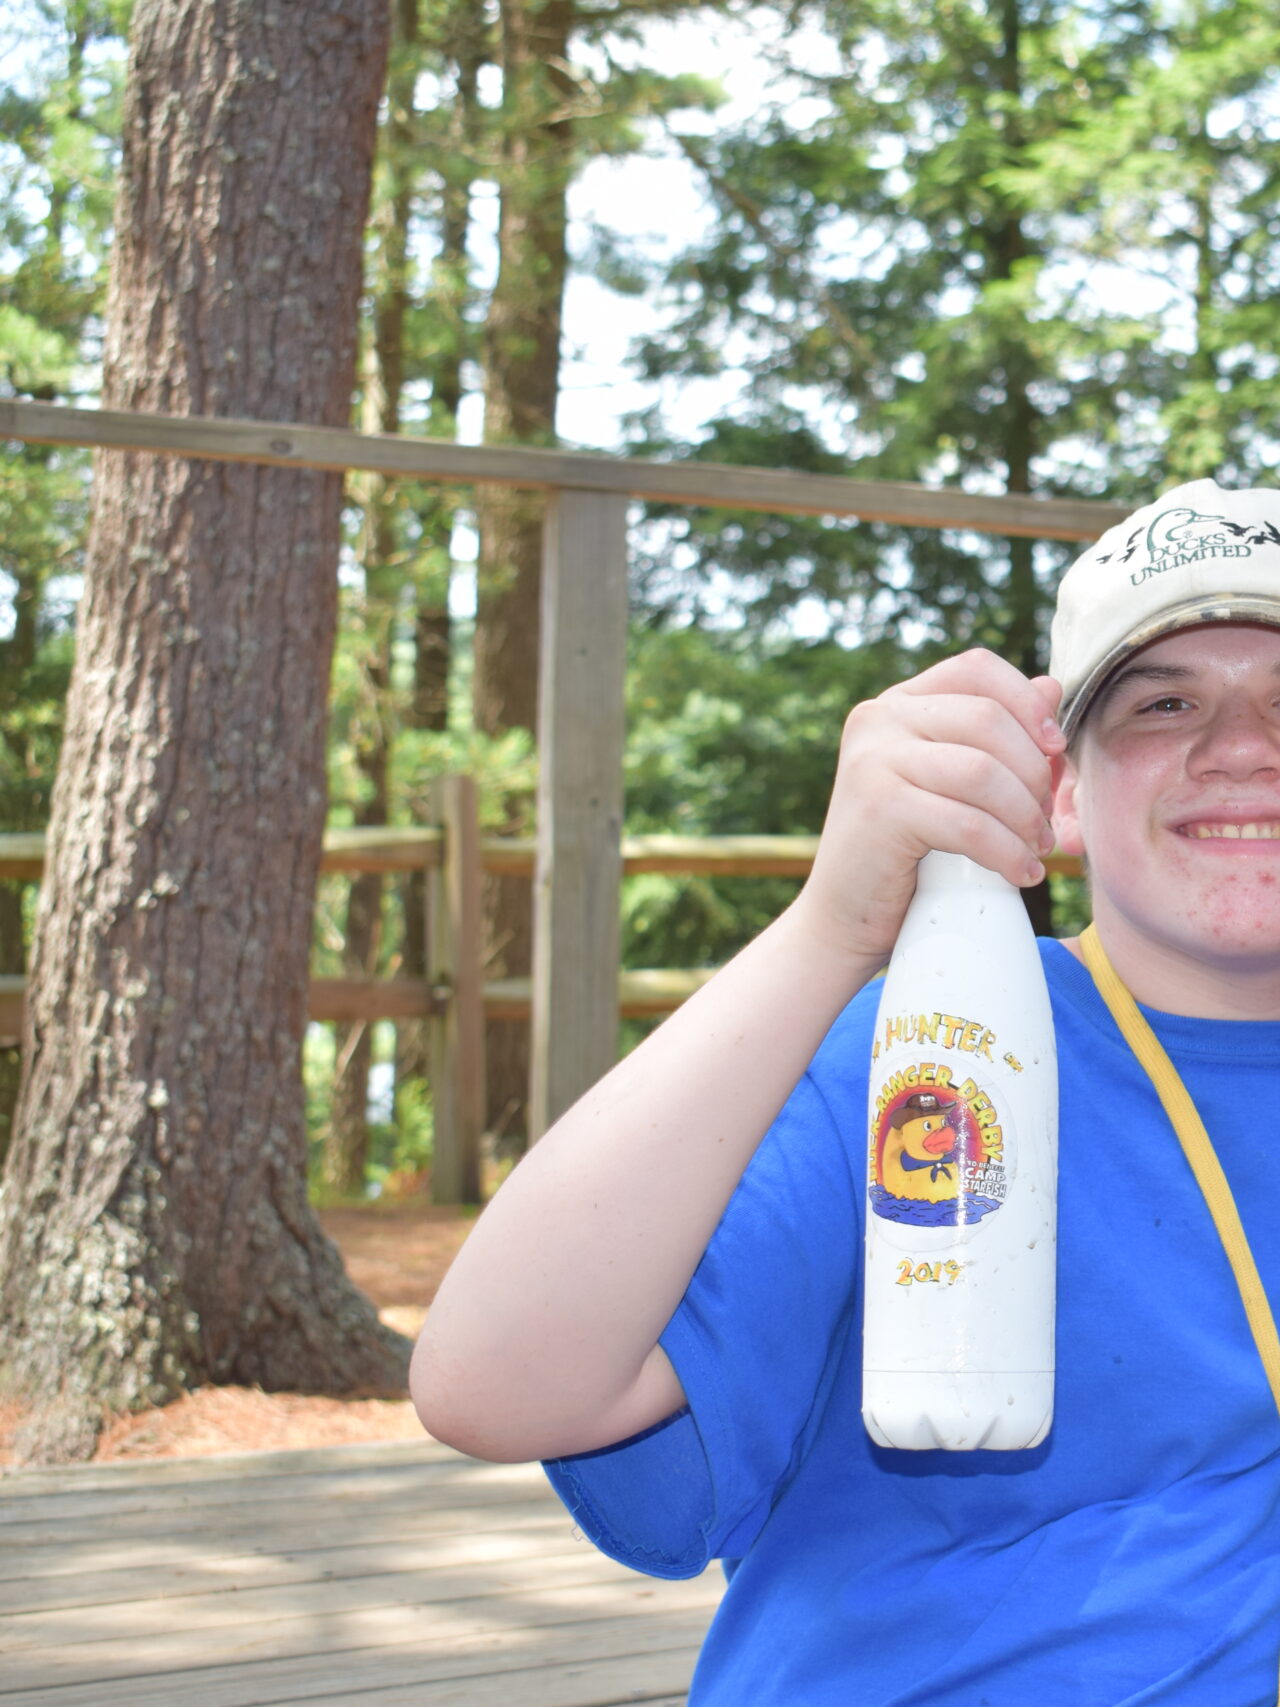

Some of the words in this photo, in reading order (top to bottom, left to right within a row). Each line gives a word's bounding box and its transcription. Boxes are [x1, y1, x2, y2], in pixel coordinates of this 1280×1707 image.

[1149, 532, 1226, 564] DUCKS
[1130, 545, 1252, 586] UNLIMITED
[885, 1012, 997, 1062] HUNTER
[875, 1062, 952, 1115] RANGER
[956, 1077, 1004, 1163] DERBY
[963, 1179, 1008, 1198] STARFISH
[965, 1167, 1006, 1182] CAMP
[895, 1257, 965, 1286] 2019
